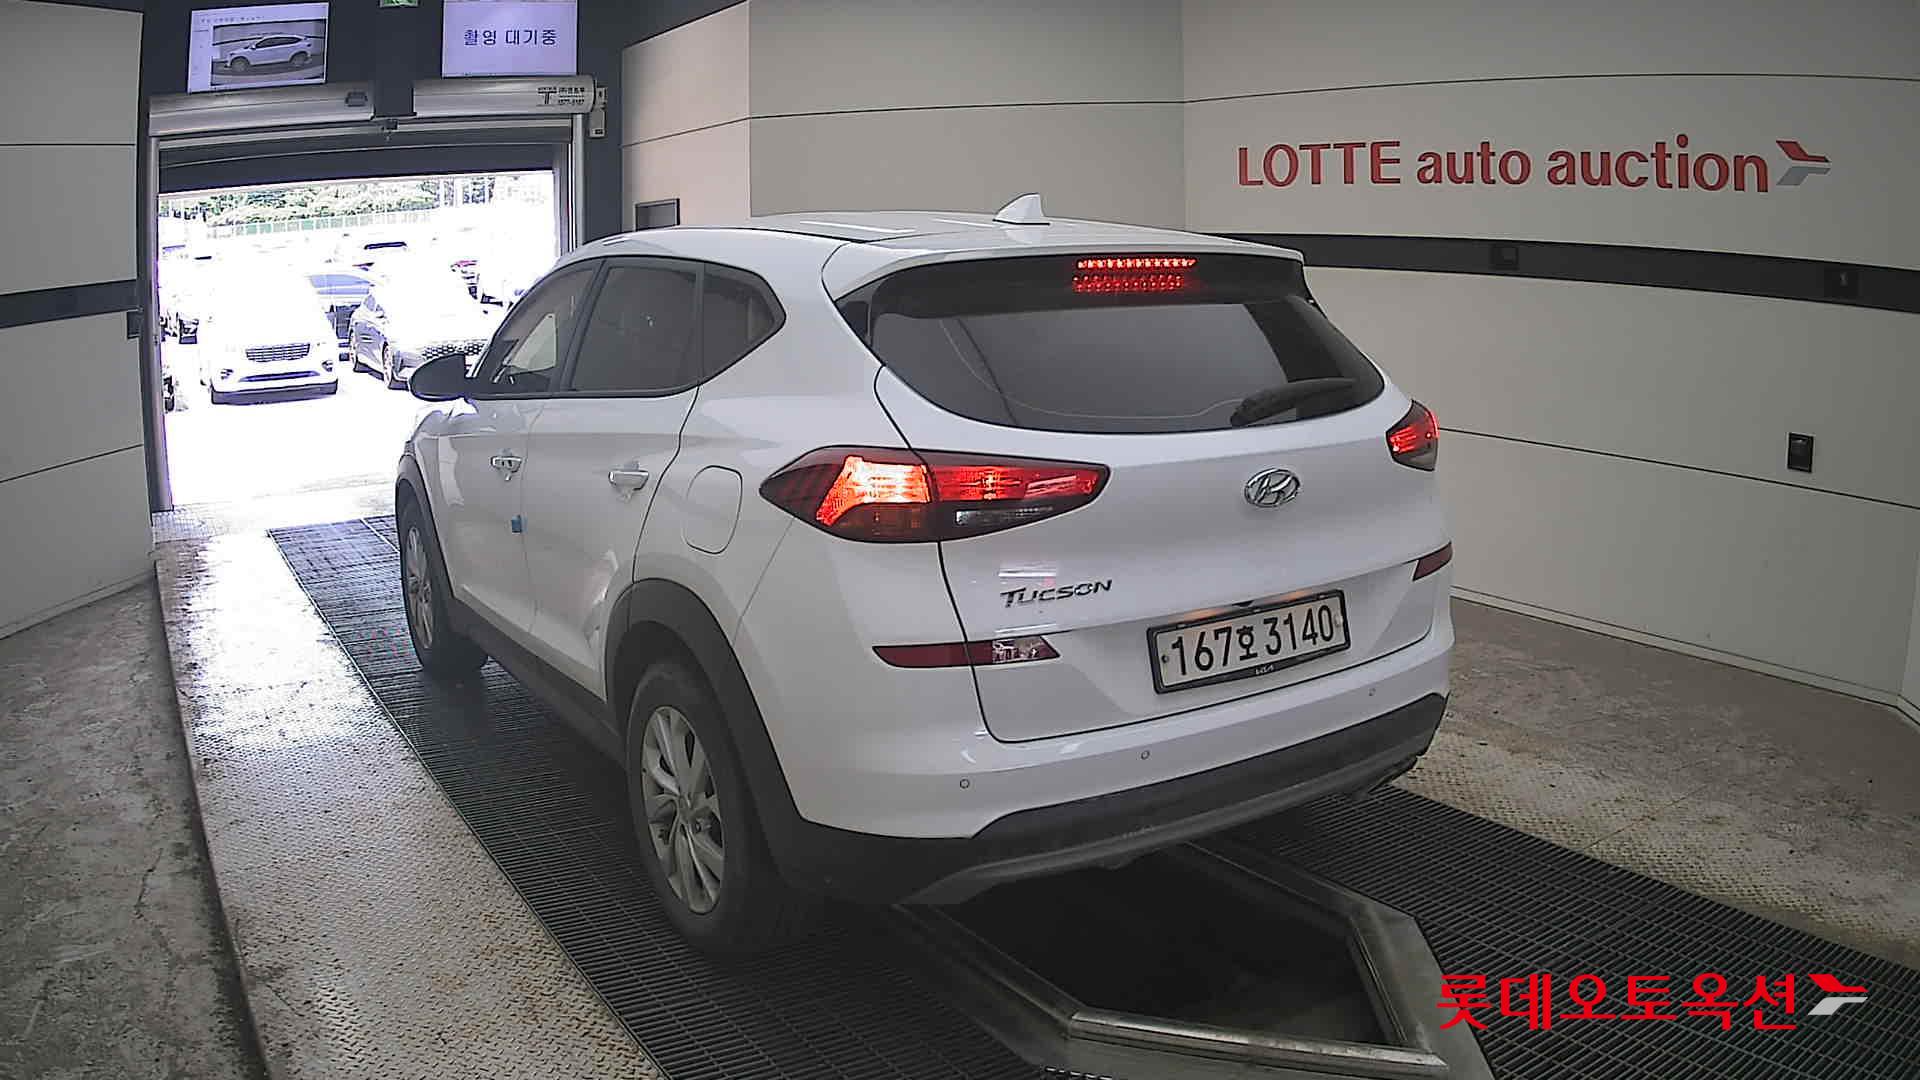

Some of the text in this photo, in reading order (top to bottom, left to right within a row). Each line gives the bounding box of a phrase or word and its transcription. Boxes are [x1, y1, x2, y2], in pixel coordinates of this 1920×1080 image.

[505, 29, 557, 46] 대기중
[1238, 134, 1768, 193] LOTTE auto auction
[1000, 579, 1112, 608] TUCSON
